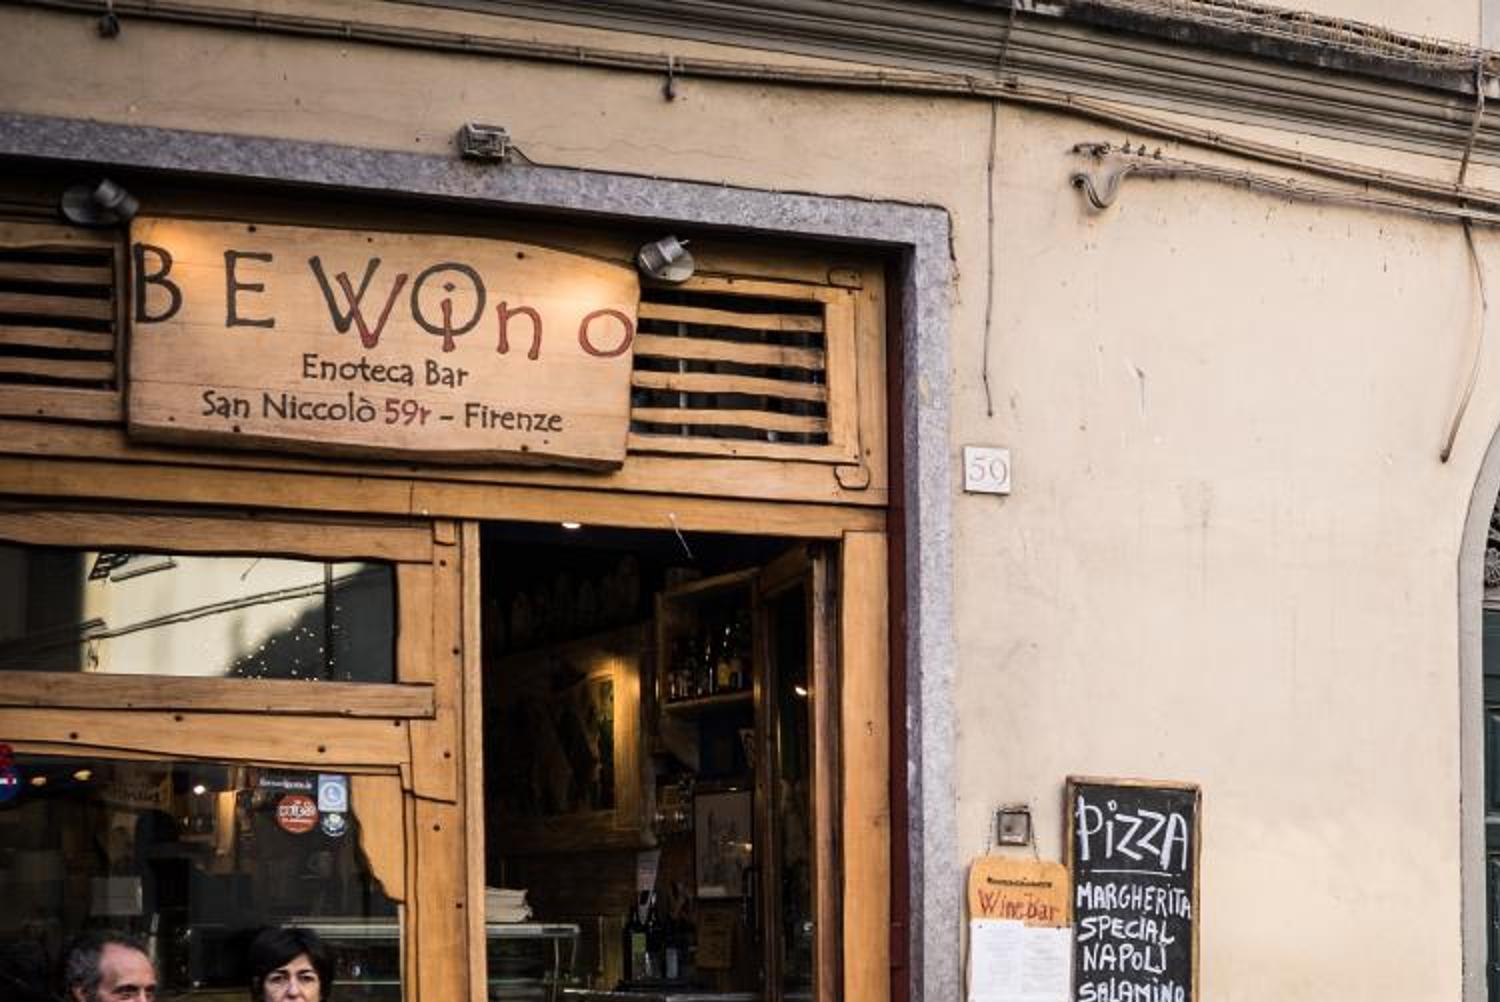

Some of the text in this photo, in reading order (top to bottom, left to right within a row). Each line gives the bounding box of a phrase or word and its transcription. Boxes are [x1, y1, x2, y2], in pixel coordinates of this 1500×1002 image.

[302, 353, 469, 388] Enoteca Bar
[202, 390, 250, 418] San
[262, 391, 376, 423] Niccolò
[384, 398, 432, 426] 59r
[464, 402, 563, 432] Firenze
[969, 455, 1007, 486] 59
